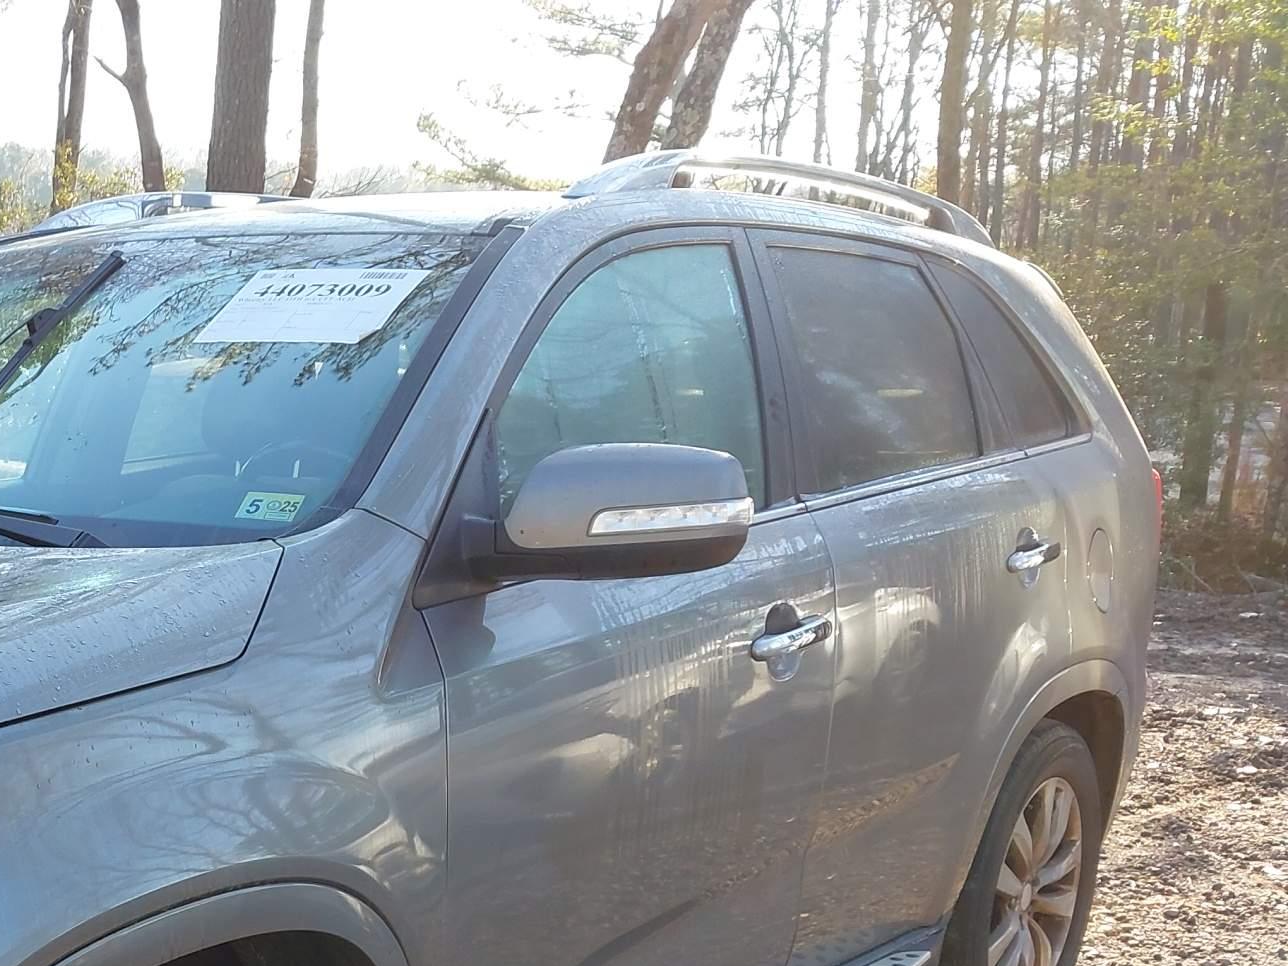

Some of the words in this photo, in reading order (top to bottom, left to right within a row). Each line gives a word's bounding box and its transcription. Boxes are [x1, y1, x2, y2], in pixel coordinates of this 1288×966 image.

[254, 283, 392, 298] 44073009
[245, 499, 264, 514] 5
[279, 501, 300, 513] 25
